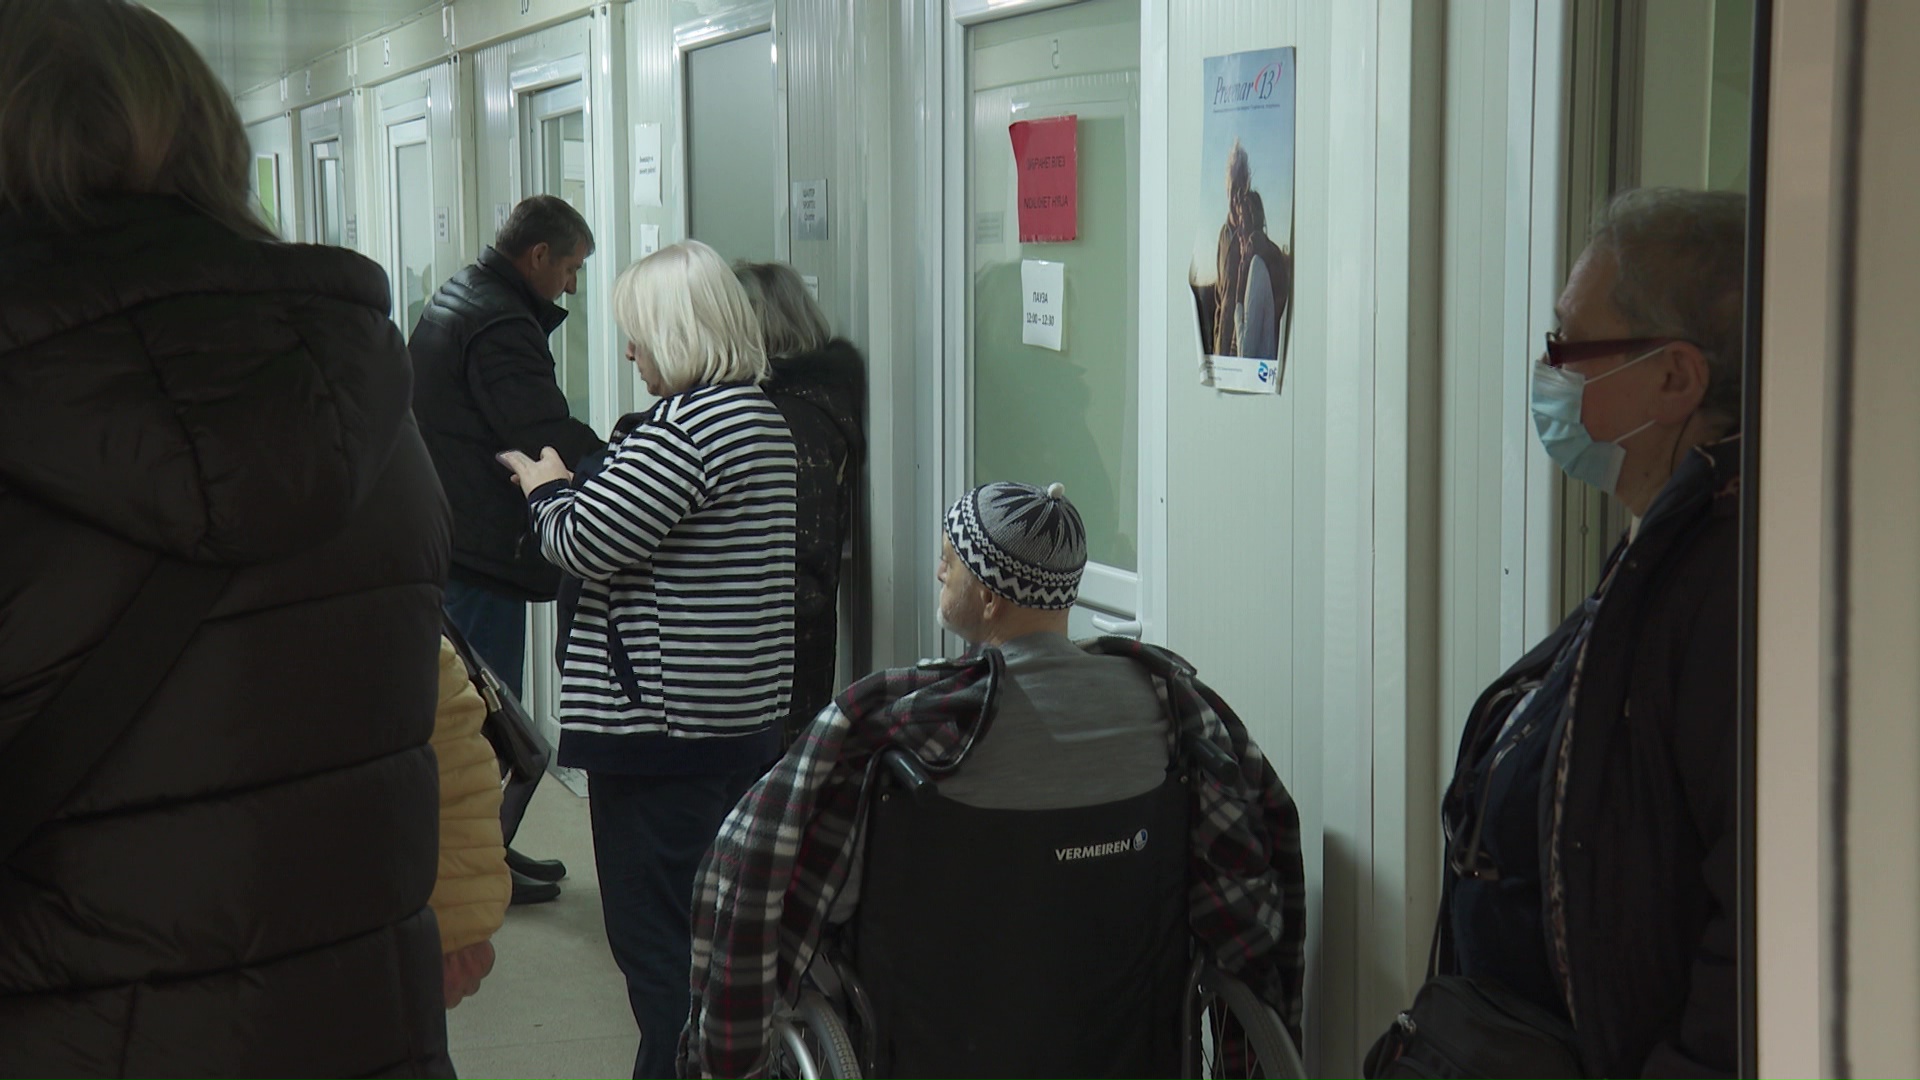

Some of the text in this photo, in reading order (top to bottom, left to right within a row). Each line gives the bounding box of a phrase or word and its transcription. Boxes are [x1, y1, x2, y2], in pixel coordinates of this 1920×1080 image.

[1259, 70, 1275, 100] 13
[1032, 291, 1048, 304] ПАУЗА
[1055, 838, 1131, 861] VERMEIREN
